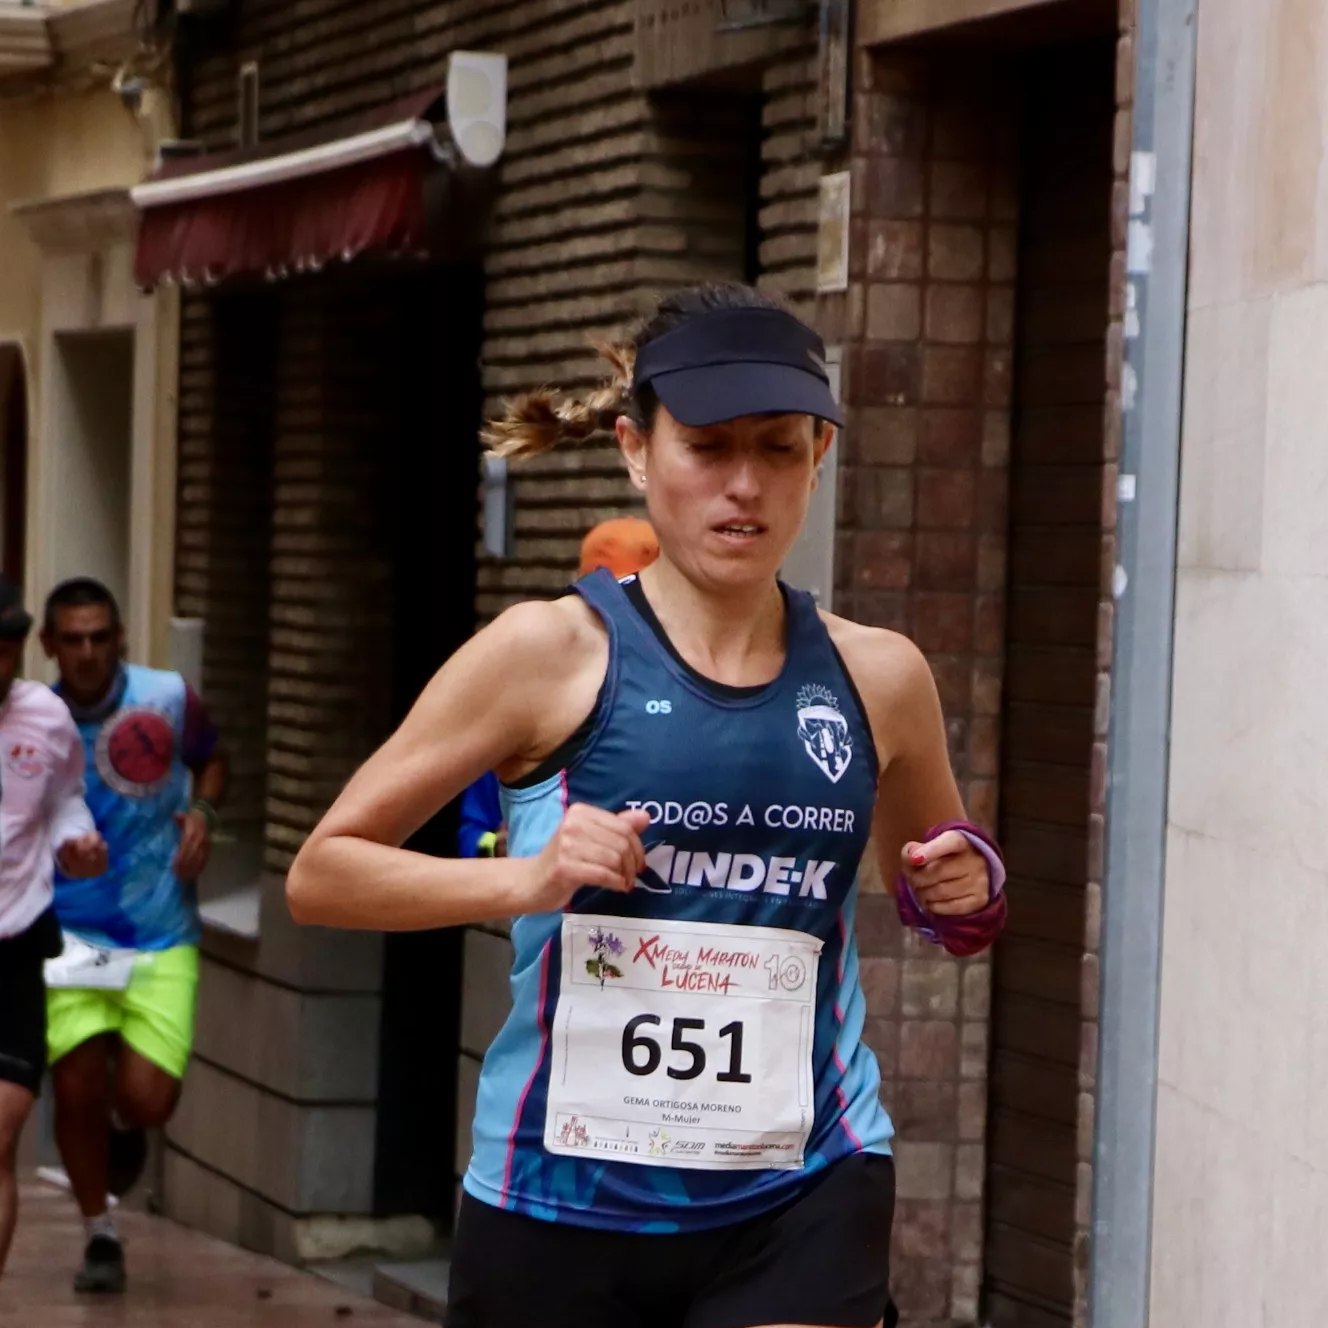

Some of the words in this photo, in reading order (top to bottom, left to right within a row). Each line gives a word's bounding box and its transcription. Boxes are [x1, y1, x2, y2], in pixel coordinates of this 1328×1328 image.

[625, 800, 729, 830] TOD@S
[735, 803, 755, 826] A
[764, 804, 855, 833] CORRER
[660, 963, 741, 995] LUCENA
[621, 1013, 752, 1084] 651
[623, 1095, 650, 1107] GEMA
[652, 1099, 699, 1112] ORTIGOSA
[700, 1103, 742, 1114] MORENO
[661, 1113, 701, 1125] M-Mujer
